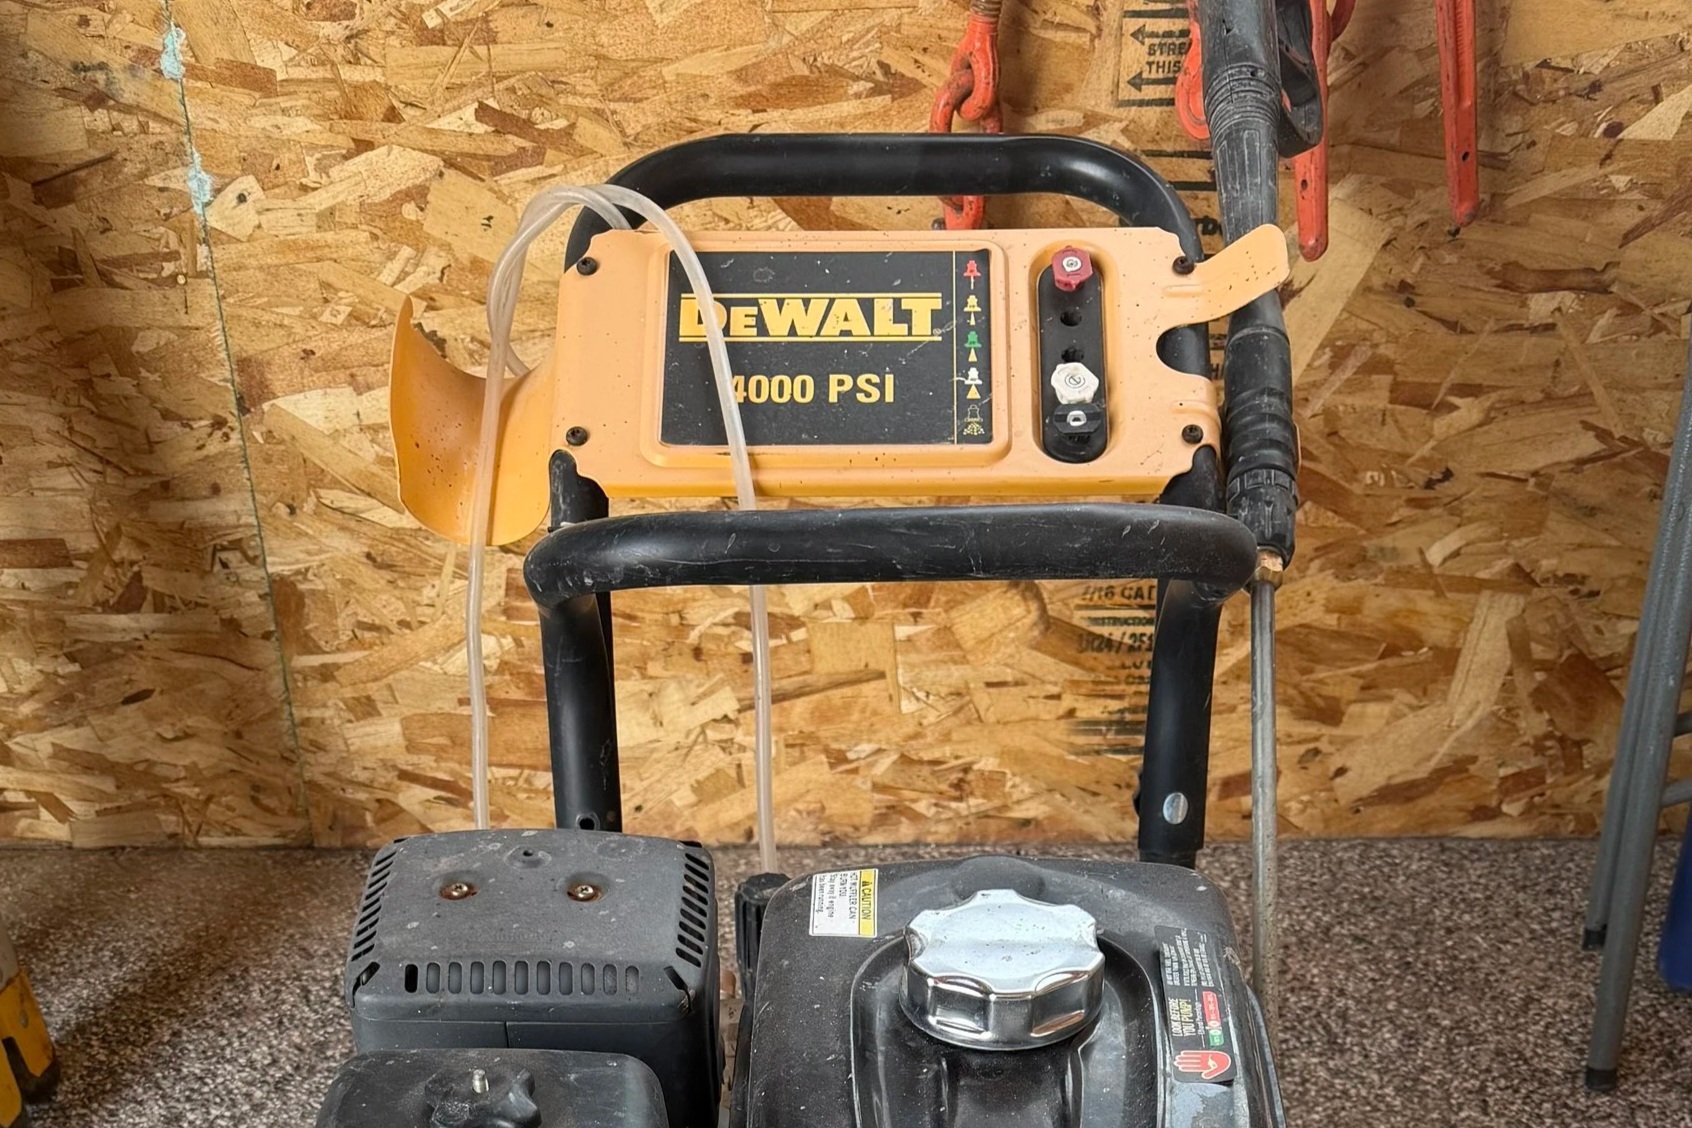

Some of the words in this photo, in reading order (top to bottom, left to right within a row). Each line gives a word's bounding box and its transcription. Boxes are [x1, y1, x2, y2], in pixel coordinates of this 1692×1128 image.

[1147, 41, 1192, 56] STRE
[1145, 60, 1181, 74] THIS
[731, 374, 815, 403] 4000
[828, 373, 895, 403] PSI
[861, 887, 872, 920] CAUTION
[849, 906, 857, 919] CAN
[1167, 996, 1181, 1020] BEFORE
[1179, 998, 1194, 1022] PUMP!
[1171, 1020, 1183, 1037] LOOK
[1182, 1023, 1196, 1036] YOU
